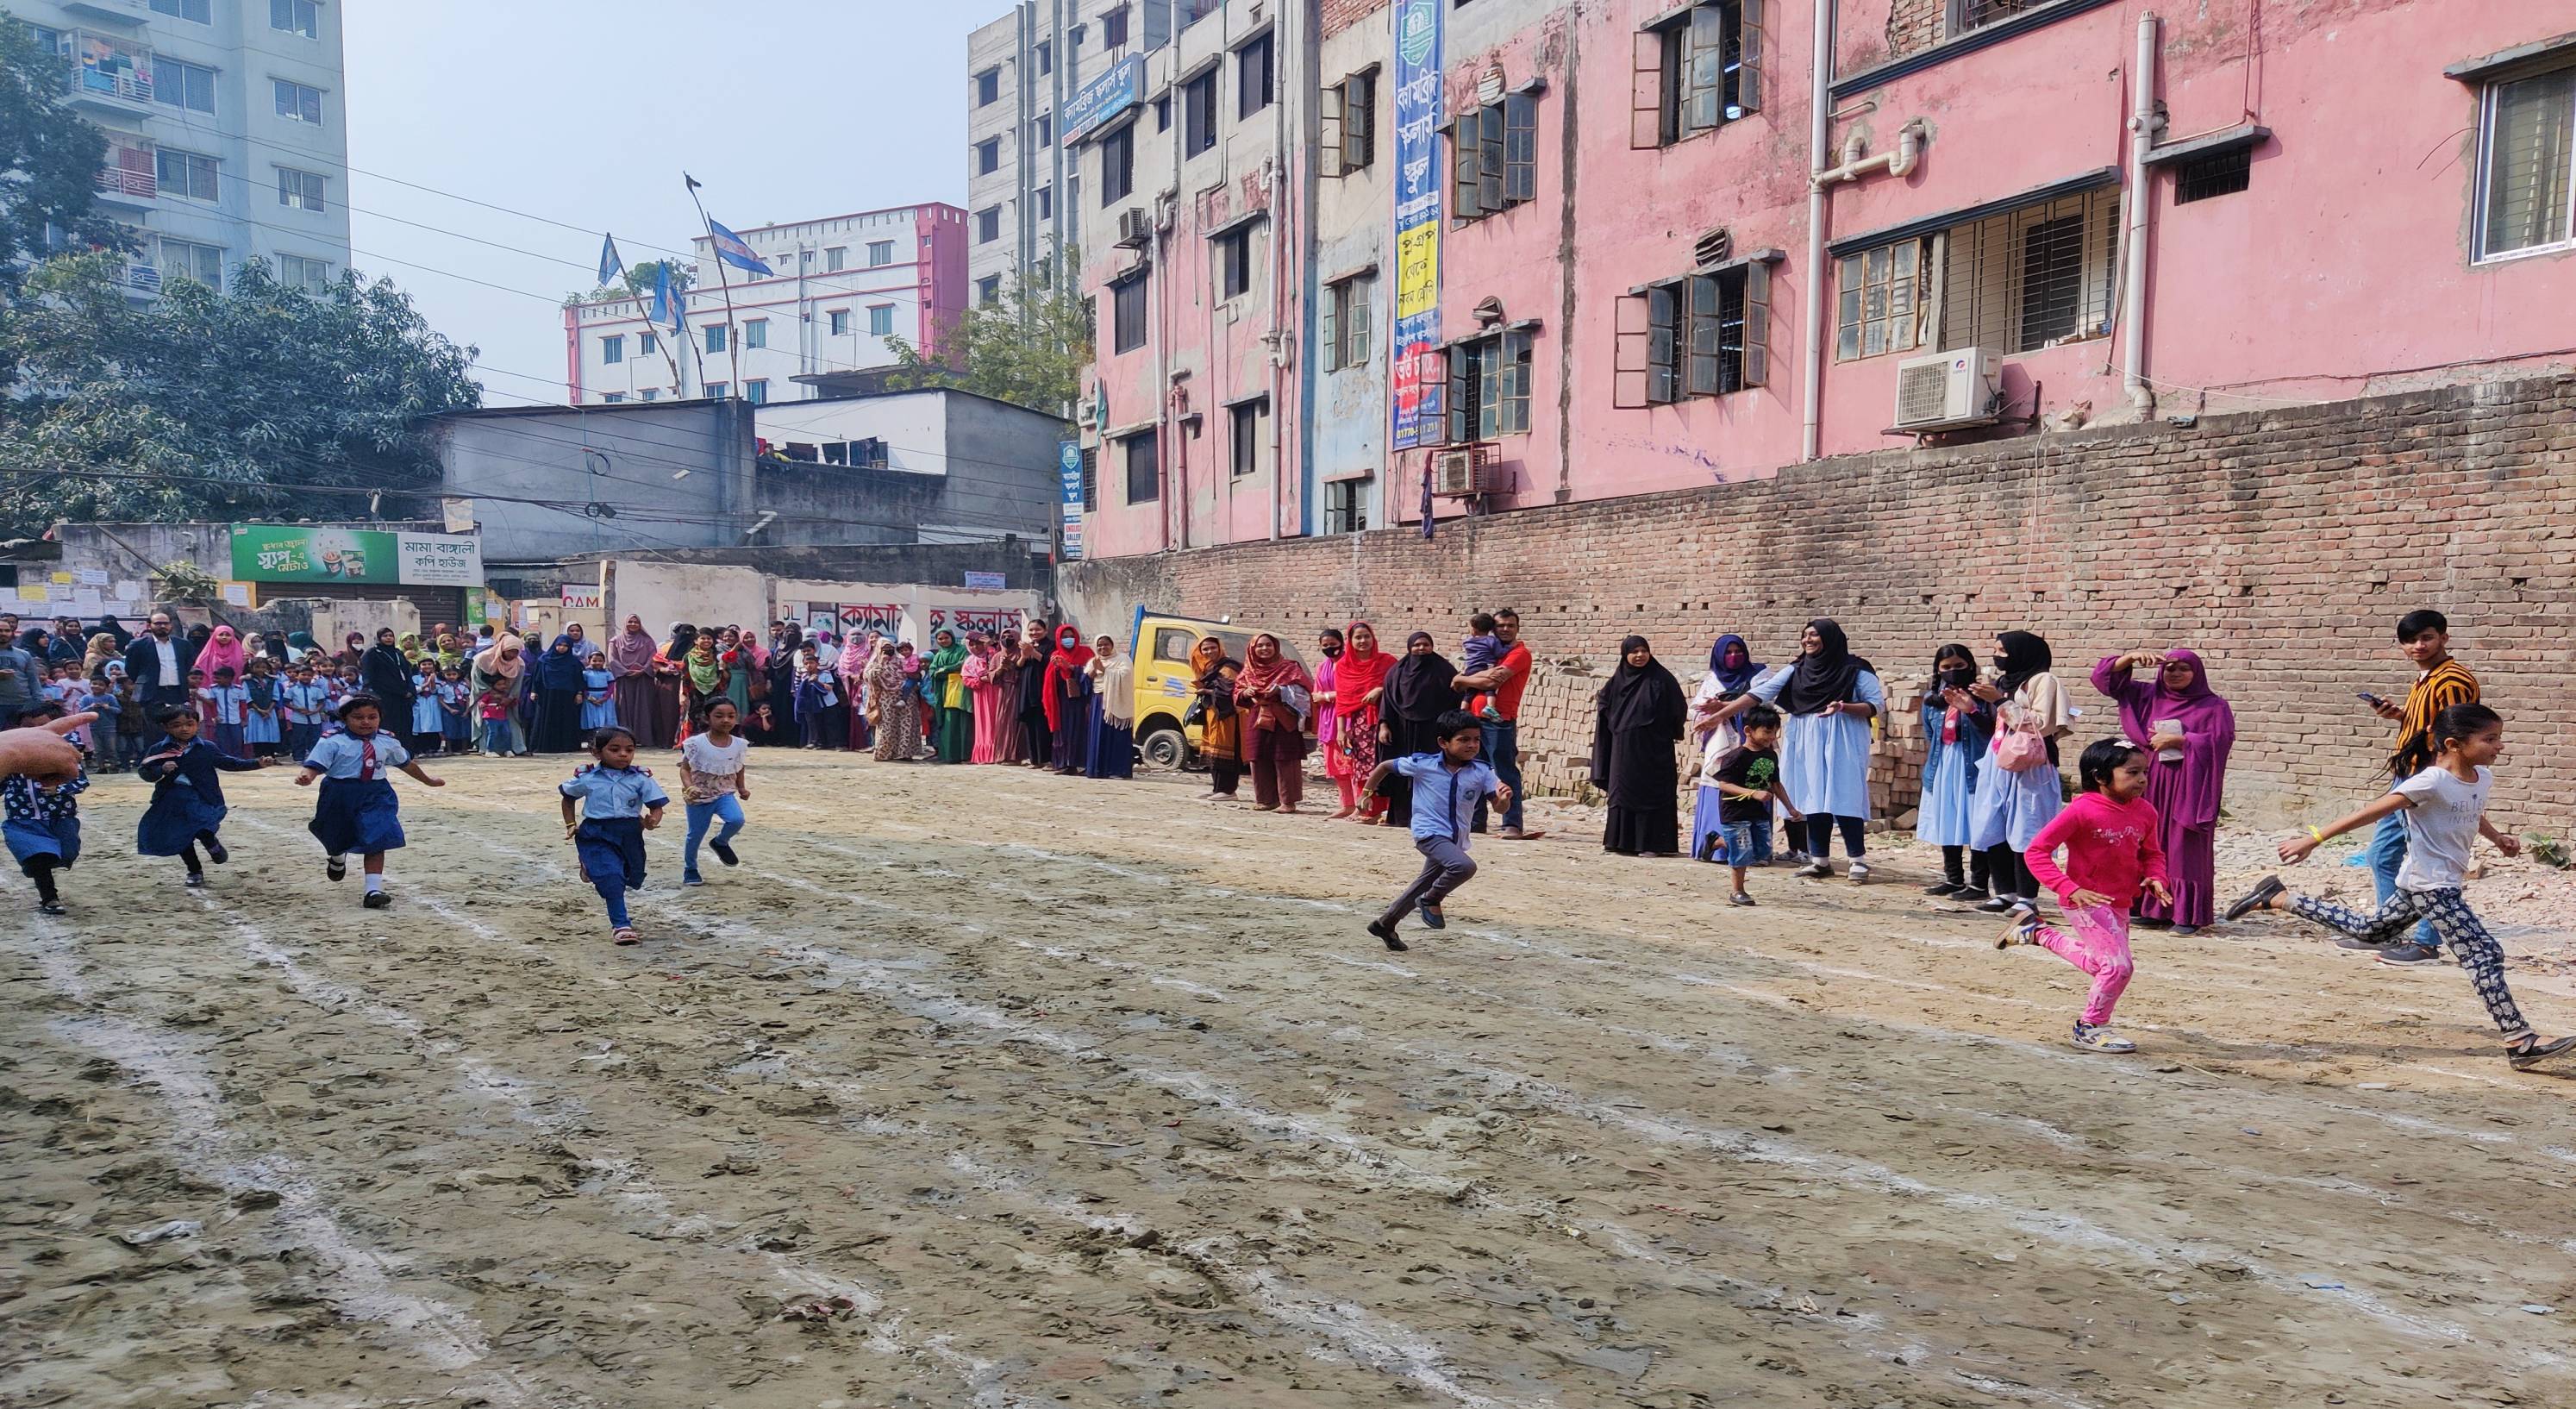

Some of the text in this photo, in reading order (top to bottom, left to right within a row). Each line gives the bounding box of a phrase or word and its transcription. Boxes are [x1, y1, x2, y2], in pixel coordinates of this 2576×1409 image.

[404, 541, 475, 554] মামা বাঙ্গালী
[415, 554, 466, 568] কপি হাউজ
[2451, 798, 2482, 812] BELIE
